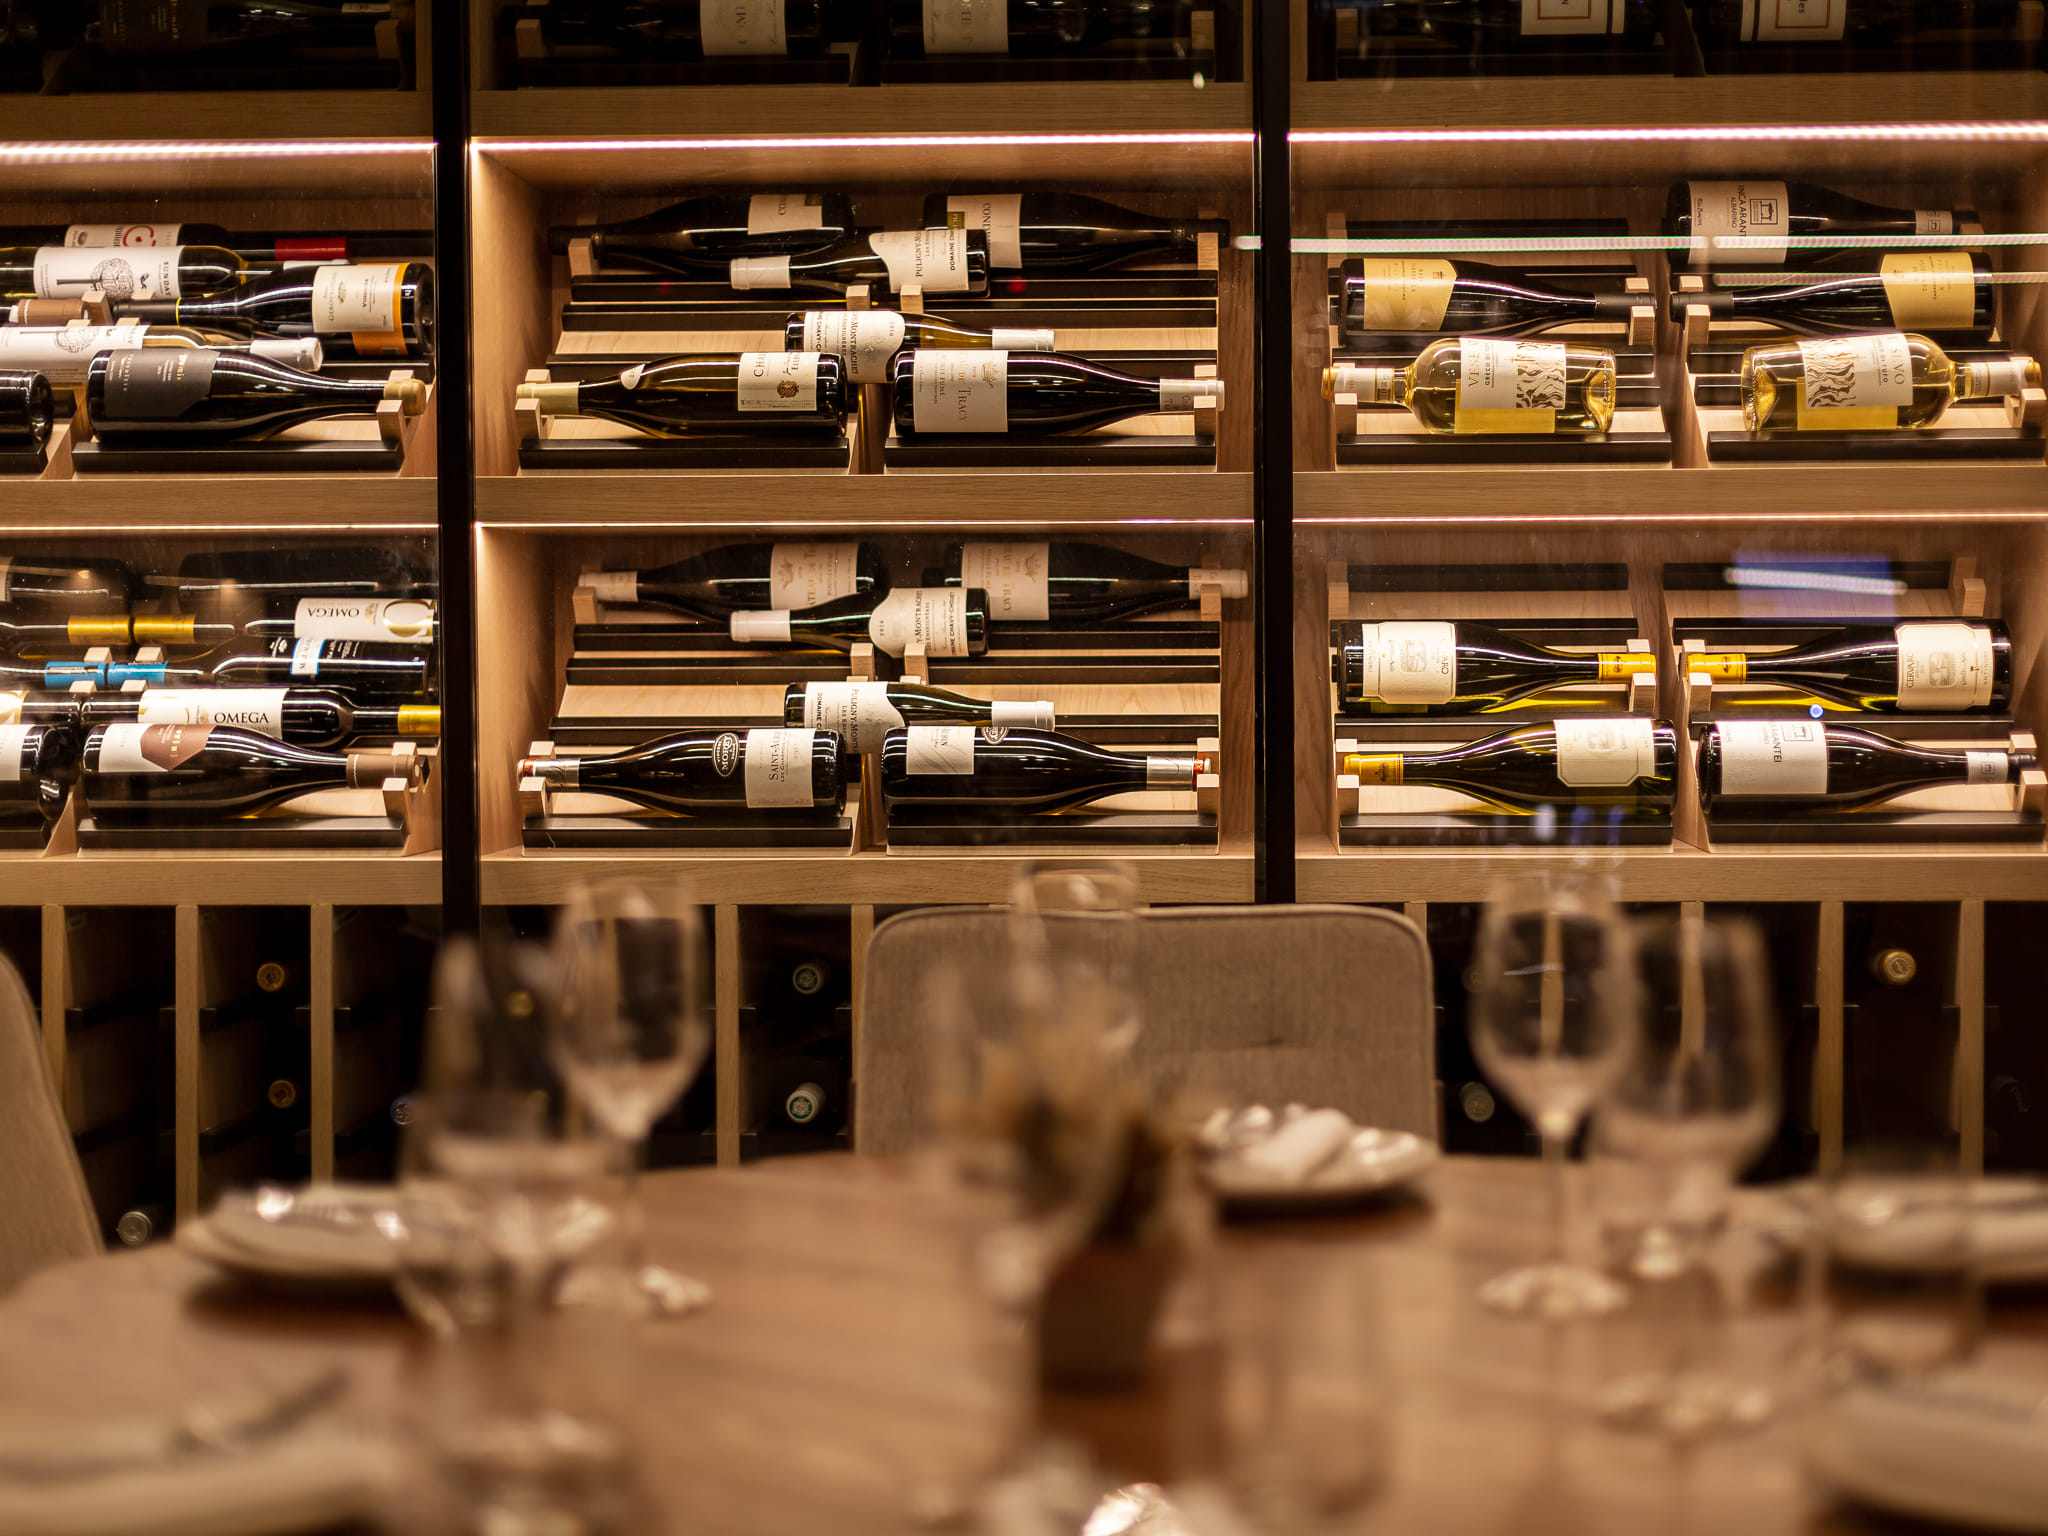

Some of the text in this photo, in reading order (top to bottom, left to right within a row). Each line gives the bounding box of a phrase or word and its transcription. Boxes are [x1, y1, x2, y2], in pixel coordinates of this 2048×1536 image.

[948, 243, 956, 271] DOMAINE
[958, 388, 972, 423] TRACY
[1003, 583, 1016, 612] TRACY
[308, 607, 360, 618] OMEGA
[214, 712, 269, 724] OMEGA
